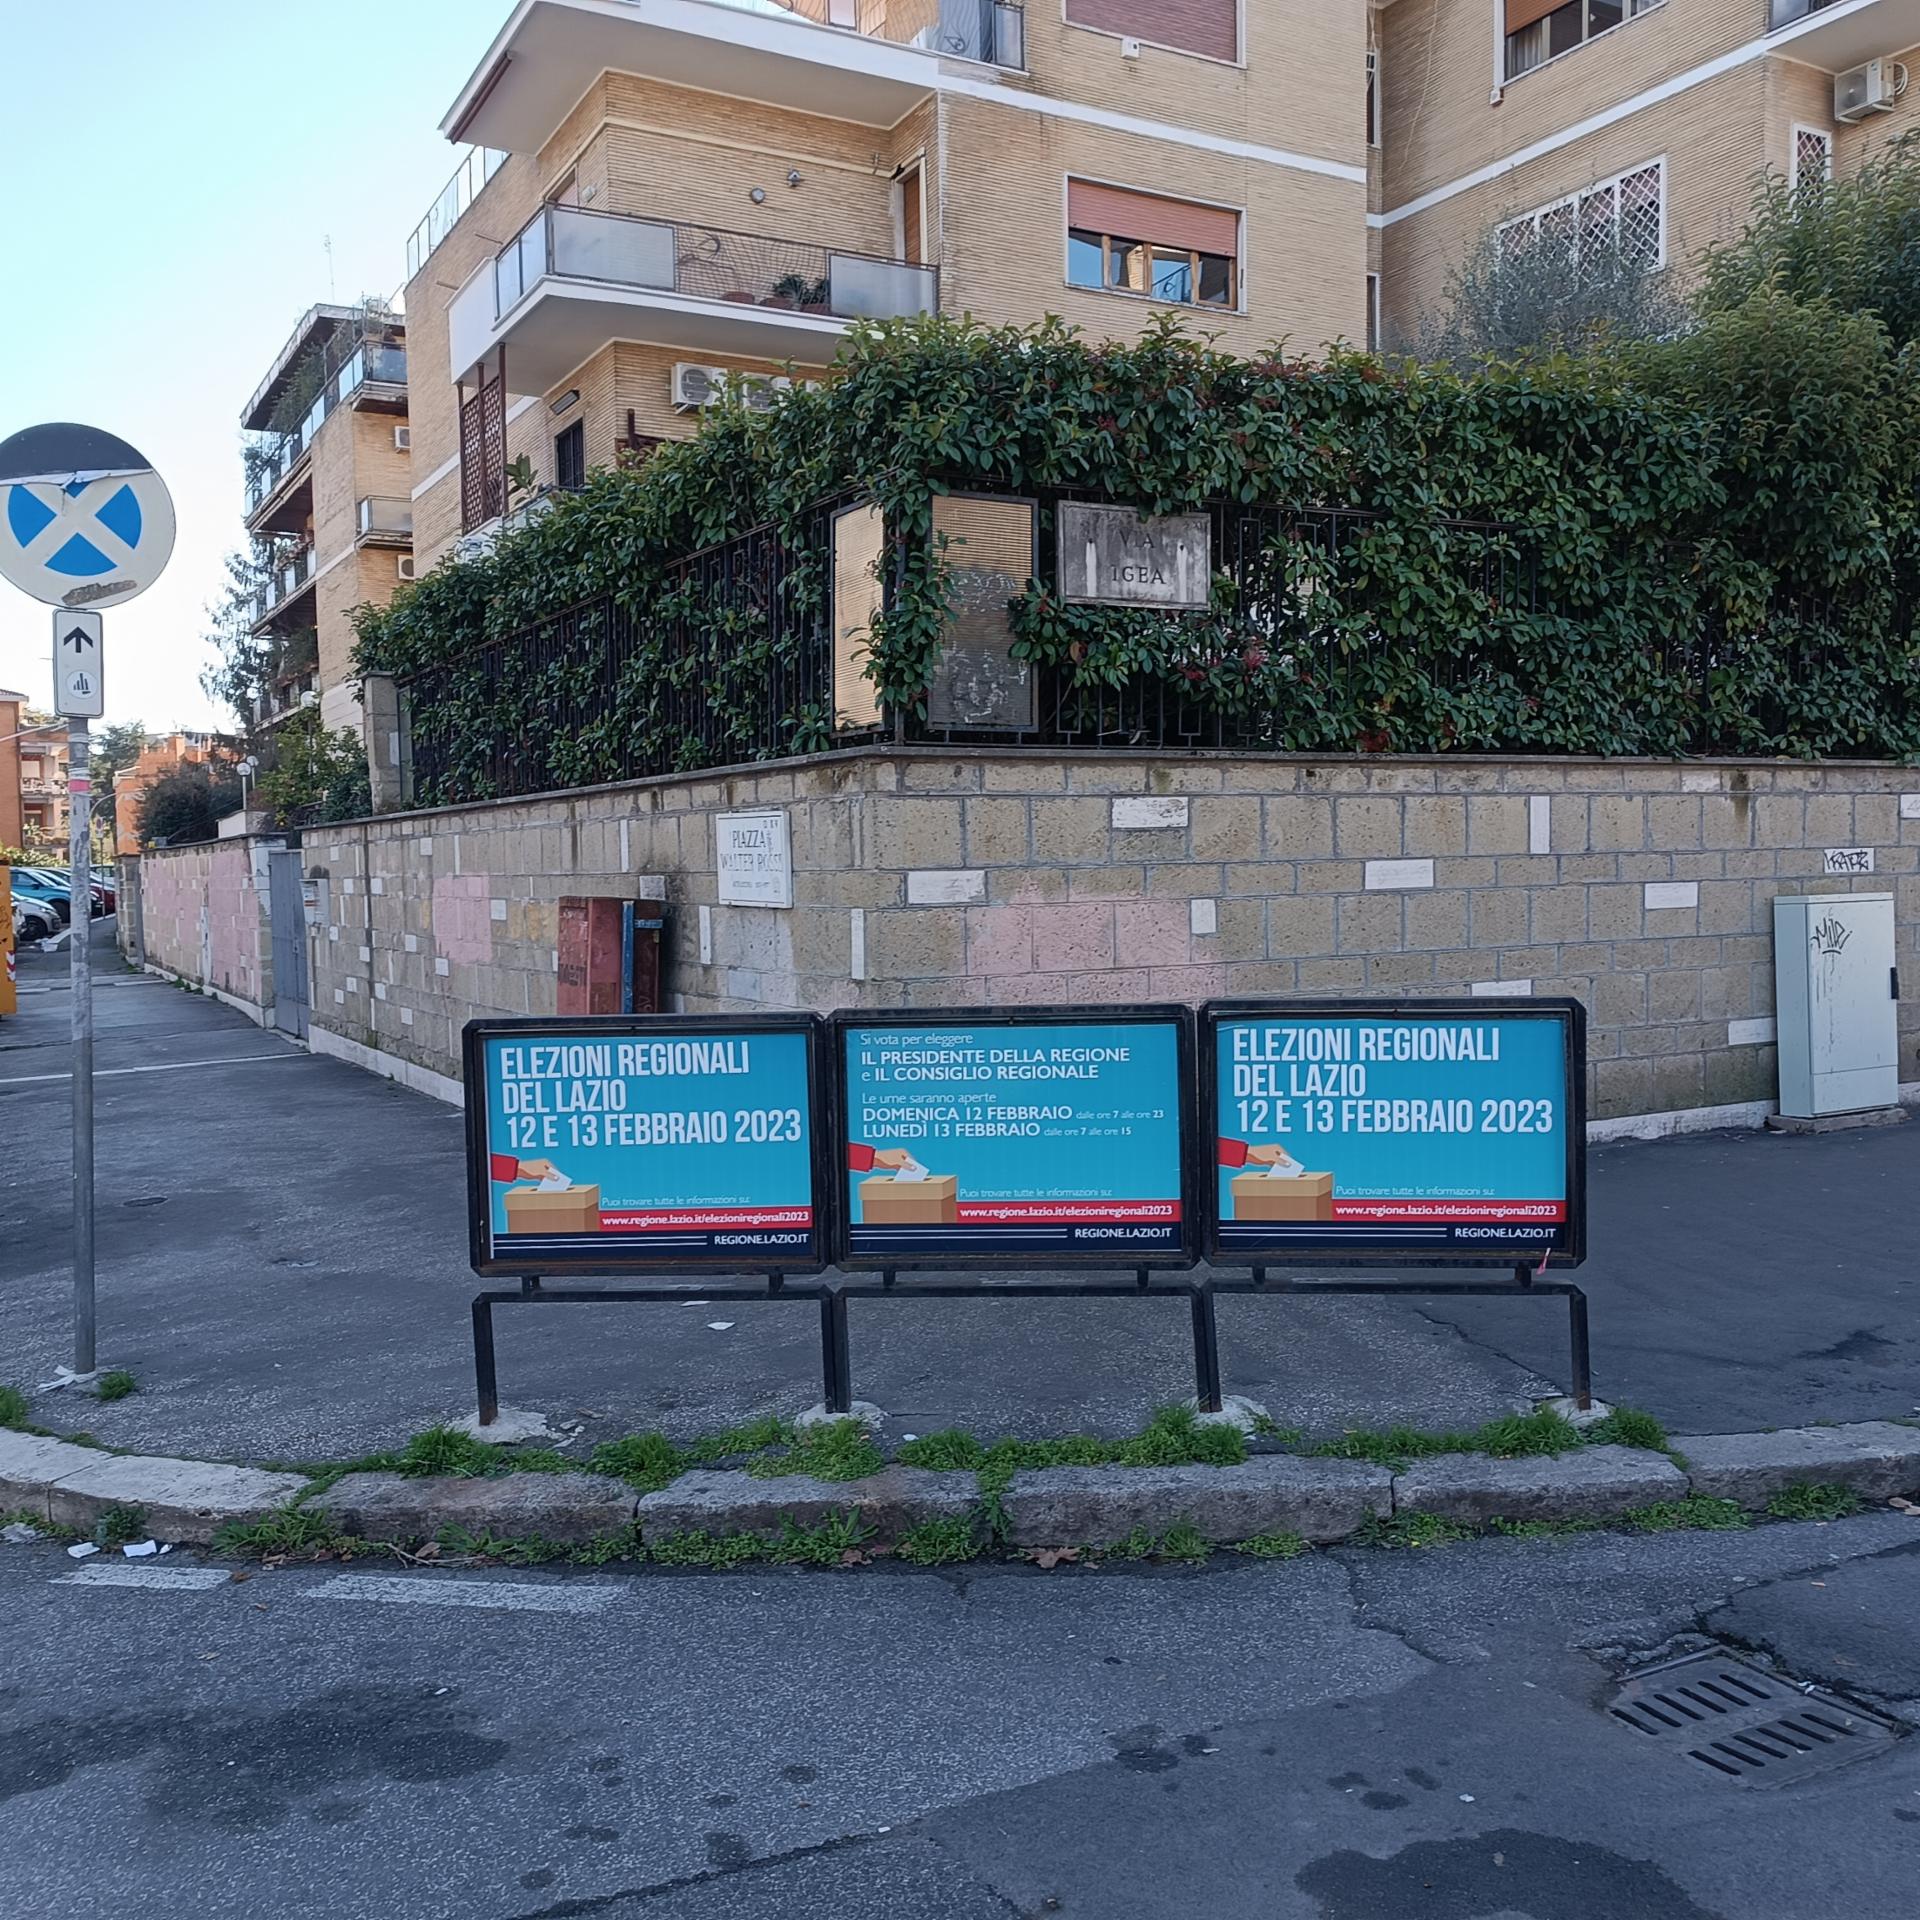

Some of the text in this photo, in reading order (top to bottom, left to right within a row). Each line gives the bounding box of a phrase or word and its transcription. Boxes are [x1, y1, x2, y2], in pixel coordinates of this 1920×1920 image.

[1119, 529, 1156, 549] VIA
[1111, 565, 1167, 585] IGEA
[732, 830, 767, 848] PIAZZA
[861, 1033, 973, 1047] Si vota per eleggere
[1233, 1027, 1499, 1061] ELEZIONI REGIONALI
[501, 1041, 749, 1079] ELEZIONI REGIONALI
[861, 1048, 1130, 1065] IL PRESIDENTE DELLA REGIONE
[862, 1065, 1099, 1081] e IL CONSIGLIO REGIONALE
[1234, 1063, 1366, 1097] DEL LAZIO
[503, 1079, 626, 1113] DEL LAZIO
[862, 1093, 876, 1104] Le
[910, 1095, 954, 1103] saranno
[958, 1093, 997, 1105] aperte
[863, 1107, 959, 1121] DOMENICA
[966, 1107, 982, 1120] 12
[987, 1105, 1073, 1120] FEBBRAIO
[1113, 1110, 1120, 1119] 7
[1153, 1110, 1165, 1119] 23
[1237, 1099, 1553, 1132] 12 E 13 FEBBRAIO 2023
[507, 1108, 801, 1148] 12 E 13 FEBBRAIO 2023
[863, 1121, 927, 1138] LUNEDÌ
[934, 1123, 950, 1137] 13
[955, 1122, 1040, 1137] FEBBRAIO
[1080, 1127, 1087, 1136] 7
[1122, 1127, 1132, 1136] 15
[981, 1189, 1012, 1198] trovare
[1336, 1186, 1356, 1196] Puoi
[1358, 1187, 1390, 1195] trovare
[623, 1198, 652, 1206] trovare
[714, 1234, 809, 1246] REGIONE.LAZIO.IT
[1074, 1227, 1173, 1239] REGIONE.LAZIO.IT
[1454, 1227, 1556, 1239] REGIONE.LAZIO.IT
